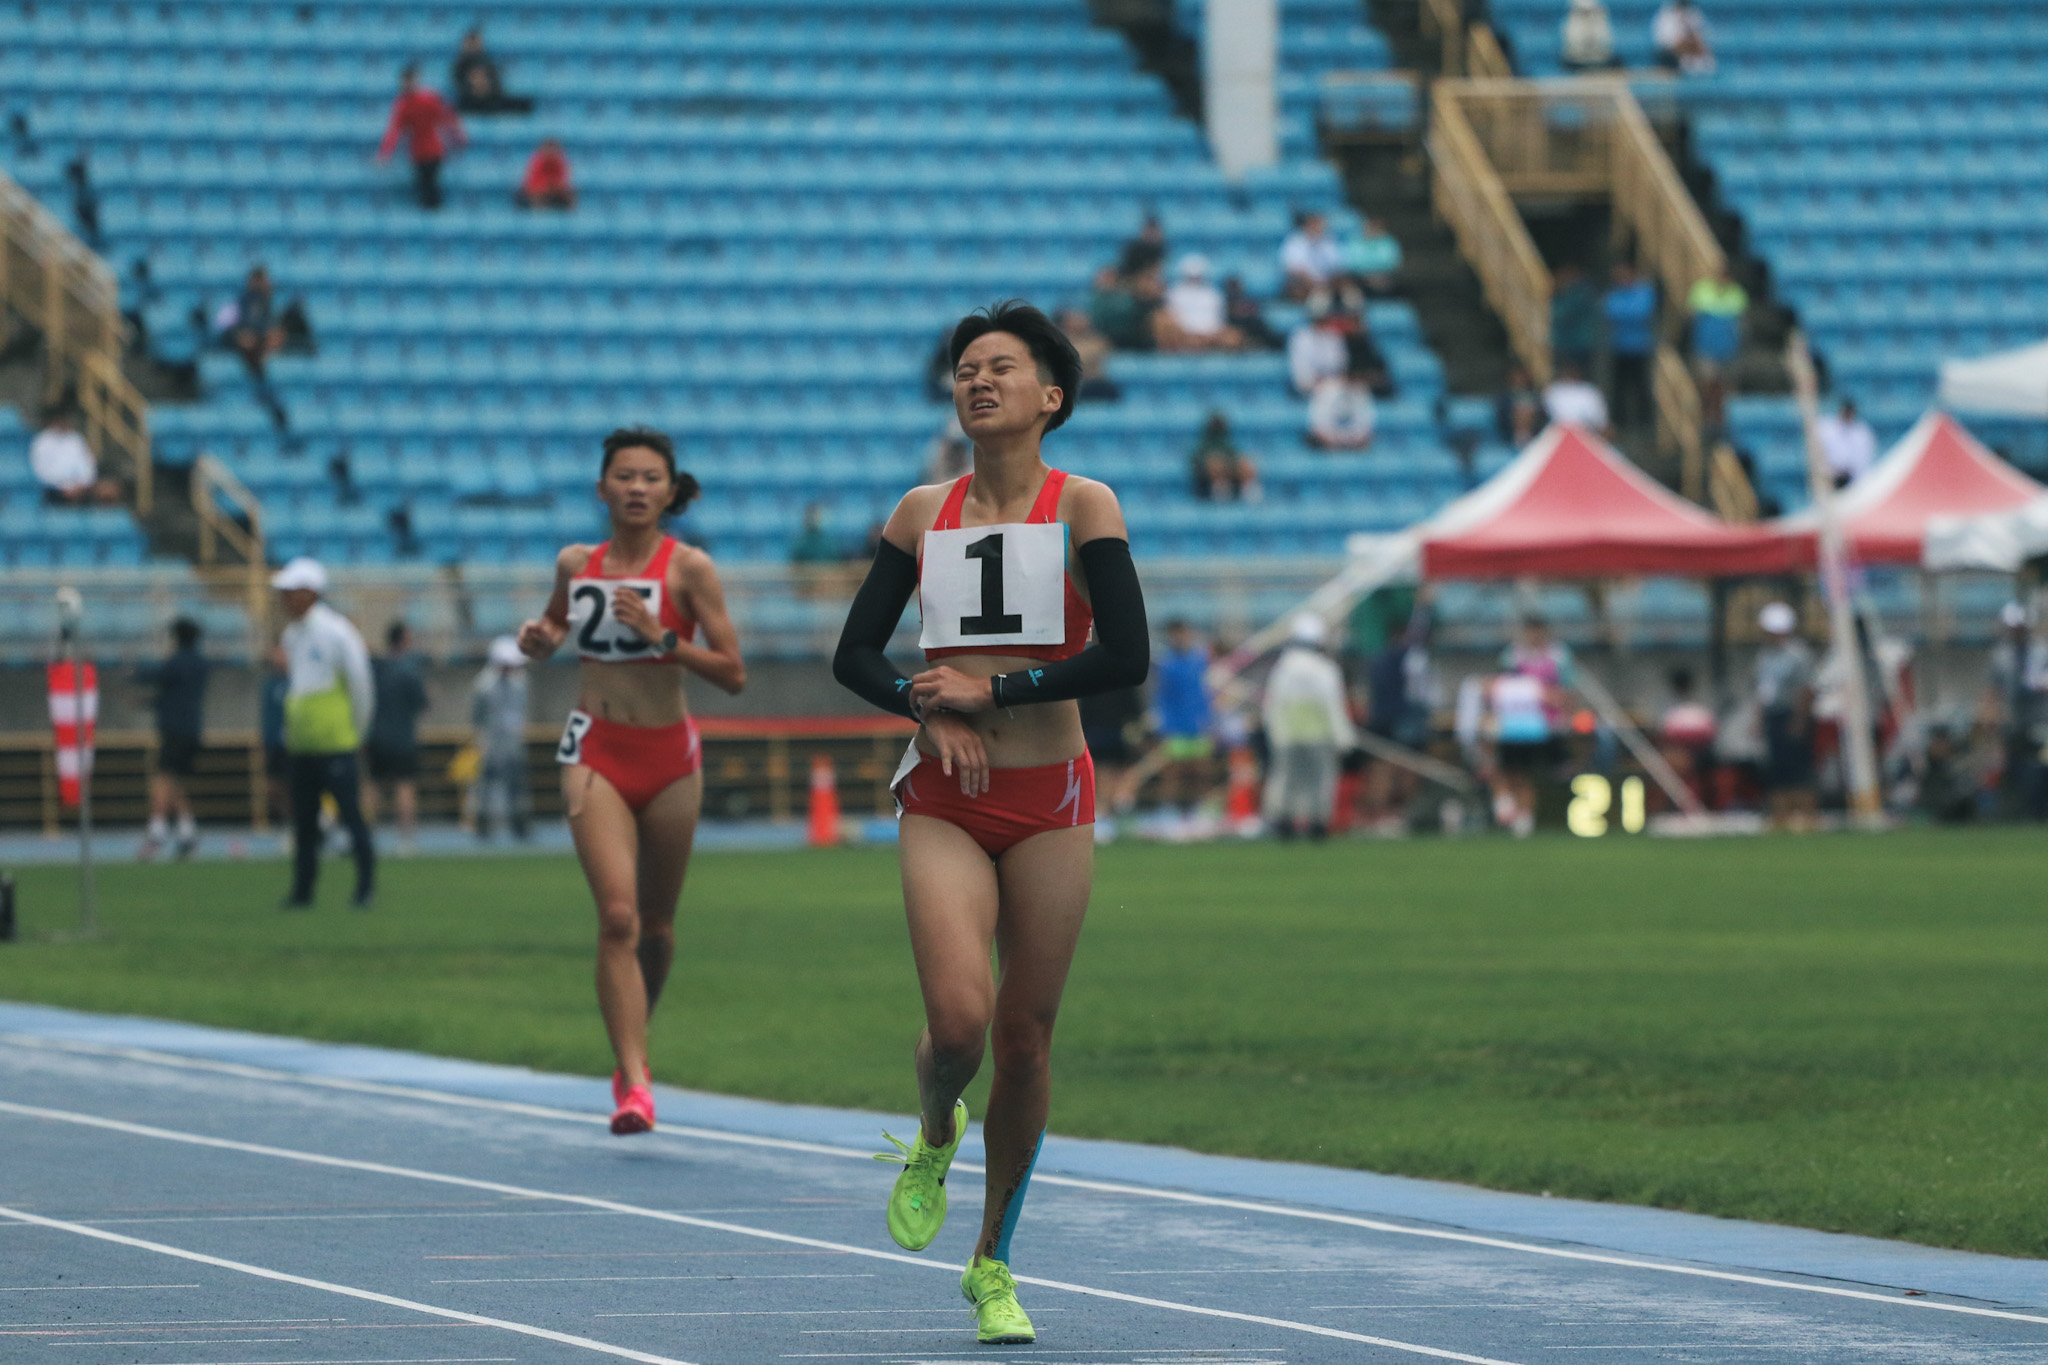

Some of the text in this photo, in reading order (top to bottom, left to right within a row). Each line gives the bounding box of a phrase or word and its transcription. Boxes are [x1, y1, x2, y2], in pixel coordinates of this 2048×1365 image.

[960, 533, 1022, 635] 1
[561, 717, 584, 757] 5
[1567, 773, 1645, 837] 21
